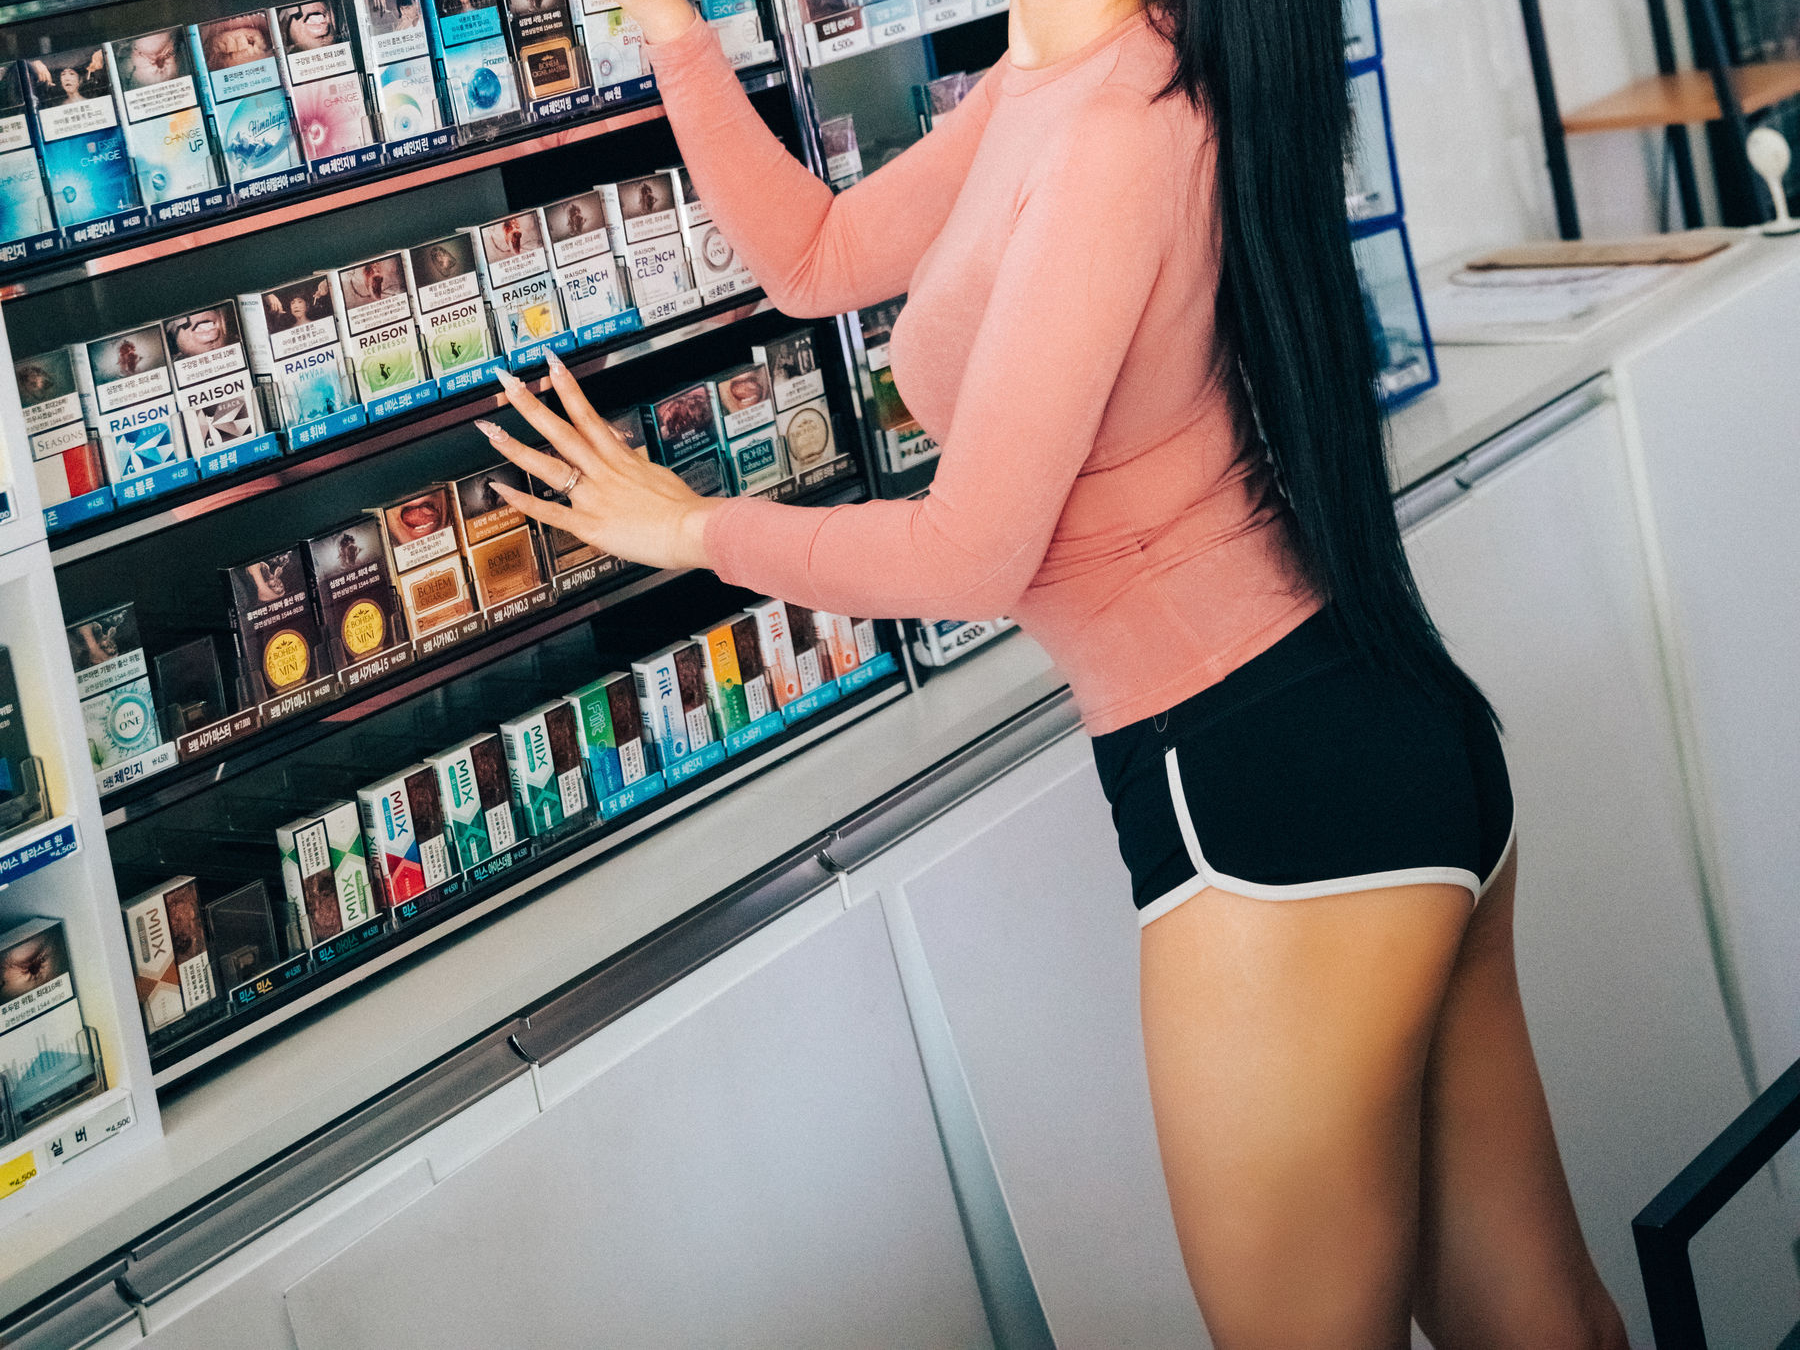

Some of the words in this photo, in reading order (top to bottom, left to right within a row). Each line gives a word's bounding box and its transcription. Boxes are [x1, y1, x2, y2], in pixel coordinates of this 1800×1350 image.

[713, 5, 733, 16] SKY
[623, 35, 641, 46] Bing
[482, 57, 507, 67] Frozen
[401, 75, 430, 88] CHANGE
[324, 93, 359, 107] CHANGE
[613, 85, 622, 100] 원
[248, 110, 286, 137] Himalaya
[164, 128, 202, 146] CHANGE
[189, 139, 203, 153] UP
[81, 151, 121, 167] CHANGE
[564, 268, 588, 279] RAISON
[502, 280, 547, 303] RAISON
[716, 281, 735, 296] 화이트
[431, 305, 478, 327] RAISON
[657, 301, 677, 318] 오렌지
[435, 326, 447, 335] ICE
[448, 316, 477, 330] PRESSO
[359, 325, 408, 349] RAISON
[377, 337, 407, 352] PRESSO
[284, 350, 335, 375] RAISON
[188, 379, 245, 407] RAISON
[218, 399, 241, 412] BLACK
[110, 404, 169, 433] RAISON
[142, 425, 163, 437] BLUE
[309, 423, 327, 440] 휘바
[37, 430, 83, 452] SEASONS
[219, 450, 238, 465] 블랙
[742, 445, 769, 462] BOHEM
[135, 478, 155, 495] 블루
[417, 577, 452, 598] BOHEM
[351, 615, 374, 629] BOHEM
[767, 610, 784, 643] Fiit
[356, 630, 374, 644] MINI
[273, 646, 298, 660] BOHEM
[279, 662, 298, 676] MINI
[656, 666, 674, 700] Fiit
[123, 710, 135, 718] THE
[119, 716, 141, 731] ONE
[531, 725, 548, 769] MIIX
[114, 761, 144, 785] 체인지
[456, 759, 475, 805] MIIX
[390, 791, 409, 837] MIIX
[0, 857, 20, 873] 이스
[54, 834, 63, 847] 원
[474, 867, 488, 881] 믹스
[342, 873, 359, 921] MIIX
[402, 902, 418, 918] 믹스
[146, 908, 166, 959] MIIX
[319, 948, 335, 962] 믹스
[335, 936, 359, 954] 아이스
[239, 987, 256, 1003] 믹스
[256, 978, 273, 994] 믹스
[2, 1002, 20, 1016] 후두암
[21, 992, 35, 1007] 위험,
[51, 1138, 64, 1157] 실
[75, 1126, 88, 1143] 버
